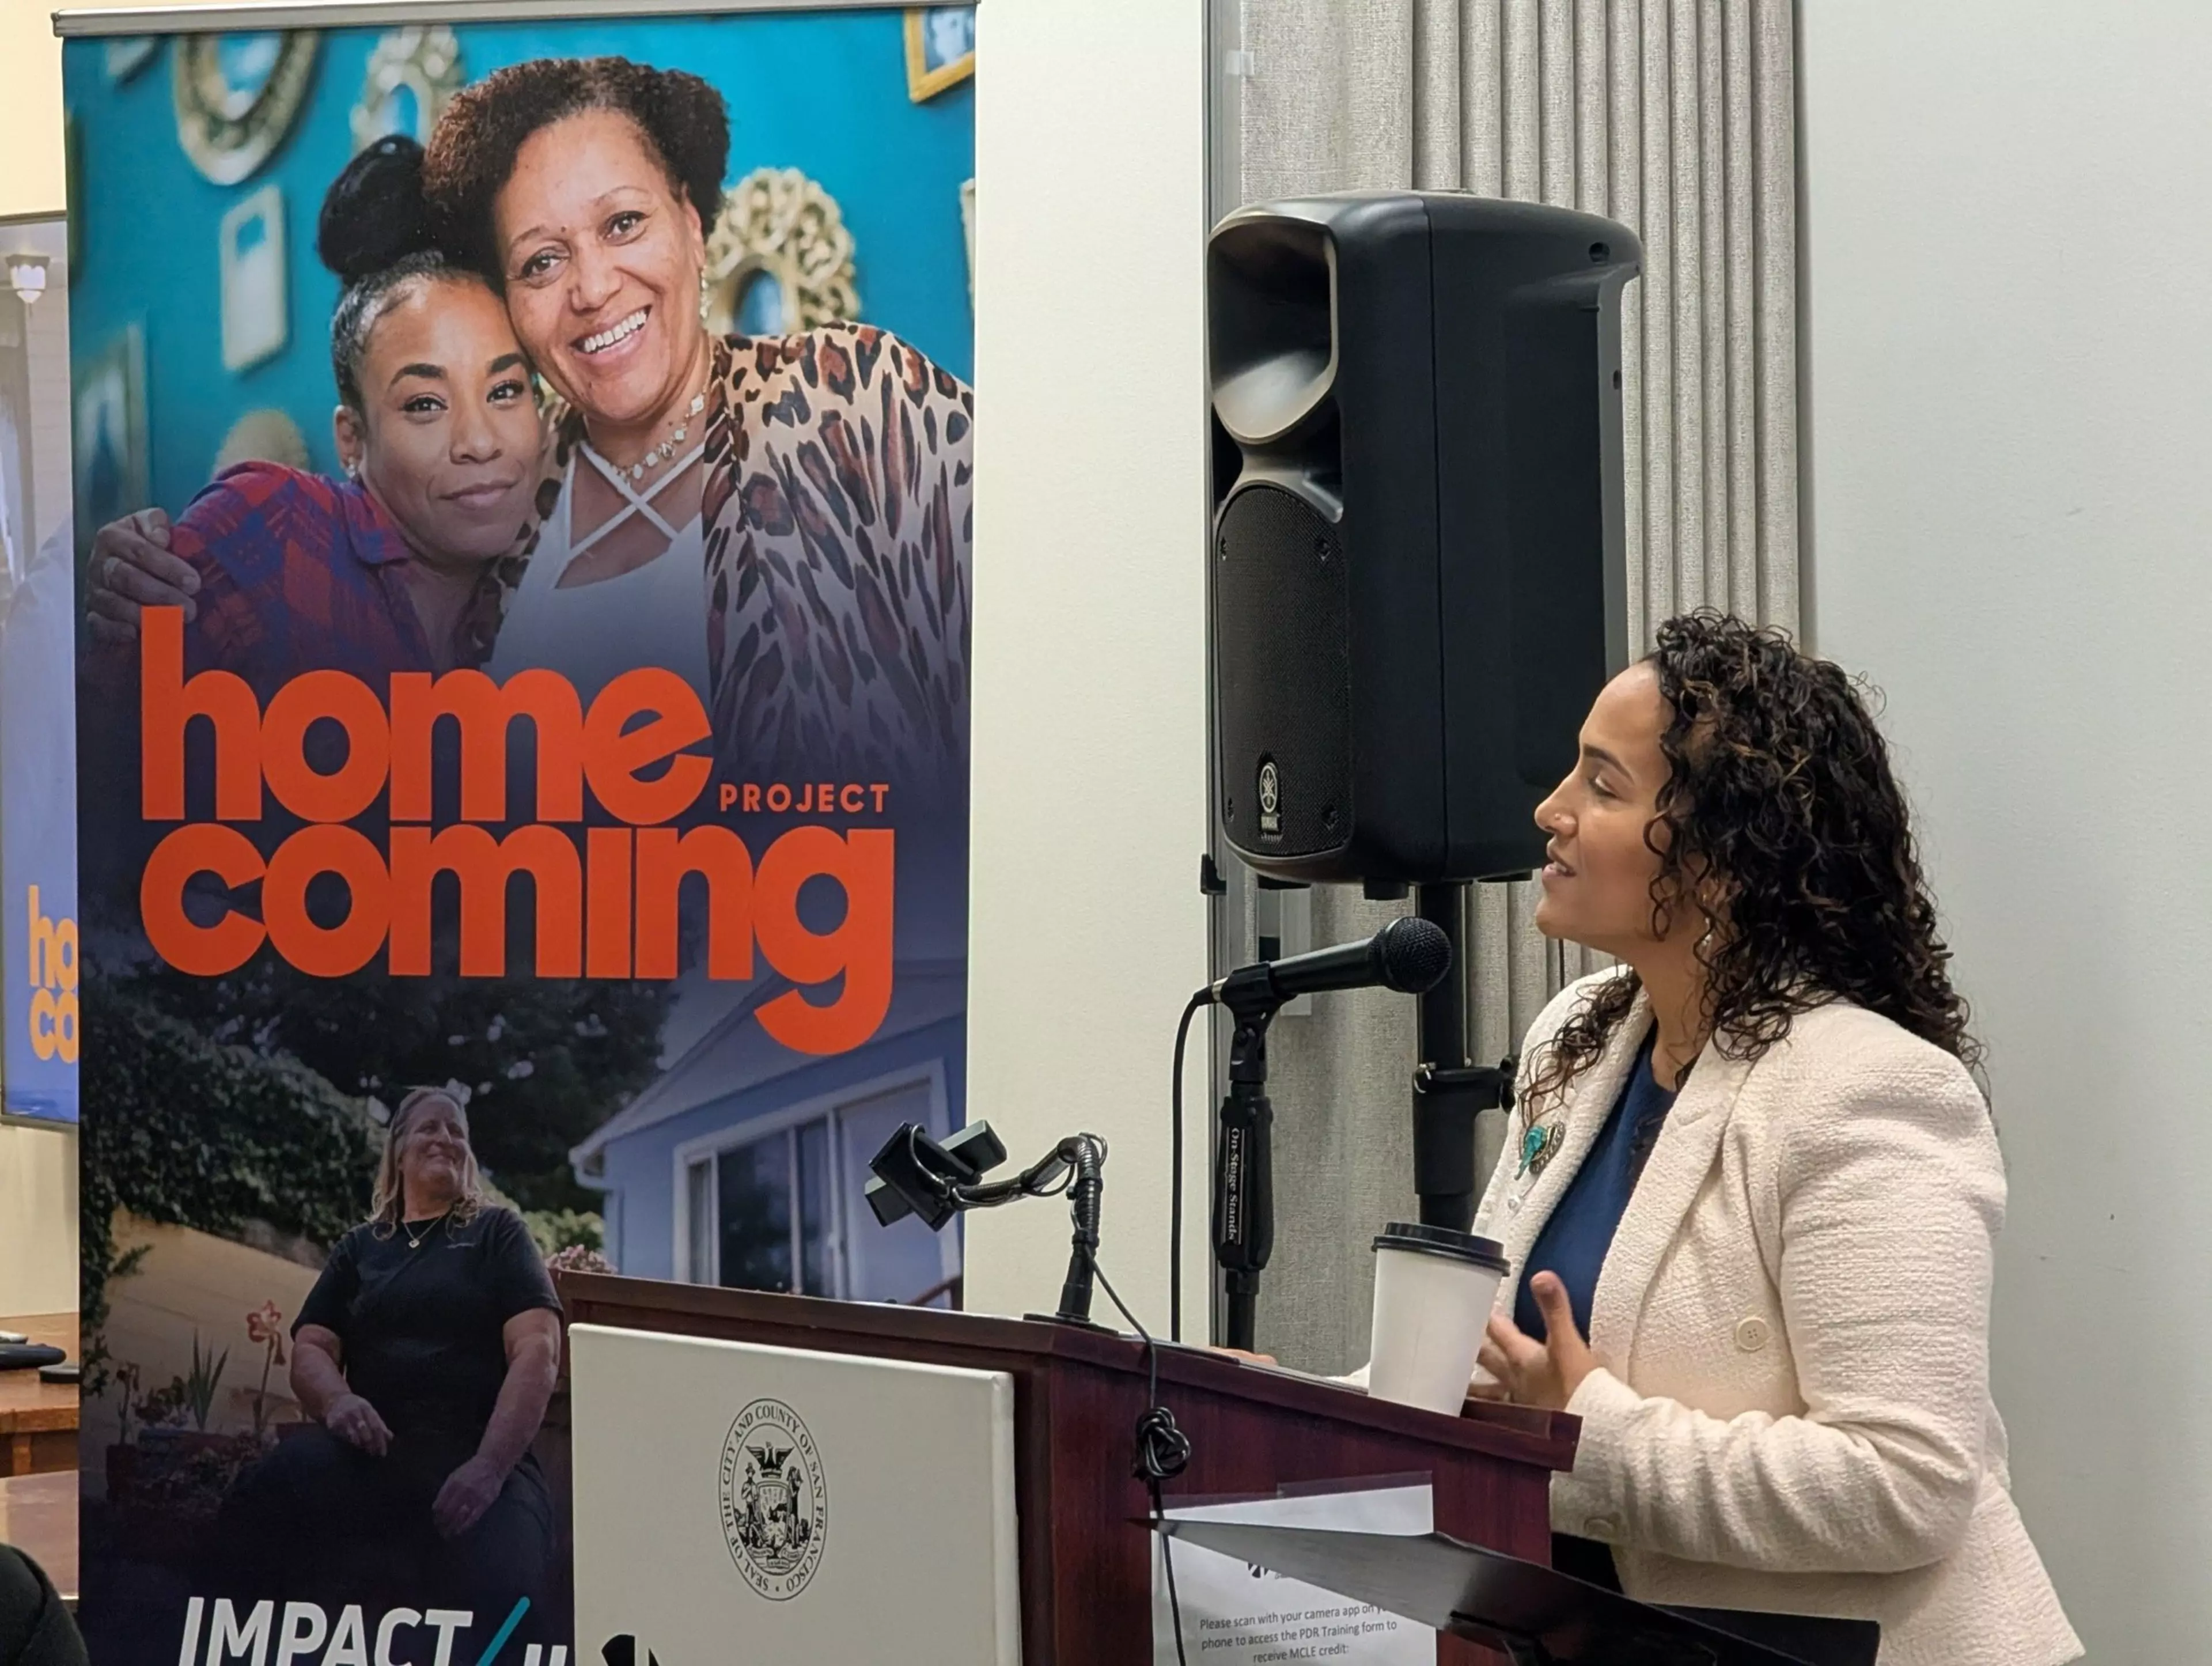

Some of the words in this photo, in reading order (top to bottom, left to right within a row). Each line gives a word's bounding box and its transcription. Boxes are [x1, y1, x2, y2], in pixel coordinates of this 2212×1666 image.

[142, 605, 714, 825] home
[720, 784, 889, 813] PROJECT
[141, 823, 895, 1055] coming
[1228, 1127, 1240, 1191] On-Stage
[1228, 1194, 1238, 1240] Stands
[734, 1412, 753, 1442] AND
[755, 1405, 800, 1433] COUNTY
[722, 1441, 736, 1486] CITY
[800, 1434, 813, 1456] OF
[810, 1461, 823, 1498] SAN
[722, 1491, 735, 1531] THE
[730, 1536, 744, 1559] OF
[786, 1506, 824, 1592] FRANCISCO
[178, 1596, 474, 1666] IMPACT
[1200, 1618, 1232, 1630] Please
[1234, 1616, 1255, 1627] scan
[1258, 1612, 1278, 1625] with
[1281, 1612, 1302, 1624] your
[1304, 1608, 1340, 1619] camera
[1343, 1606, 1360, 1616] app
[1362, 1605, 1374, 1613] on
[1202, 1637, 1233, 1651] phone
[1236, 1637, 1245, 1646] to
[1248, 1633, 1279, 1645] access
[1281, 1630, 1297, 1641] the
[1300, 1627, 1319, 1638] PDR
[1322, 1623, 1359, 1636] Training
[1362, 1622, 1384, 1633] form
[1387, 1620, 1397, 1630] to
[1253, 1649, 1287, 1663] receive
[1290, 1646, 1316, 1659] MCLE
